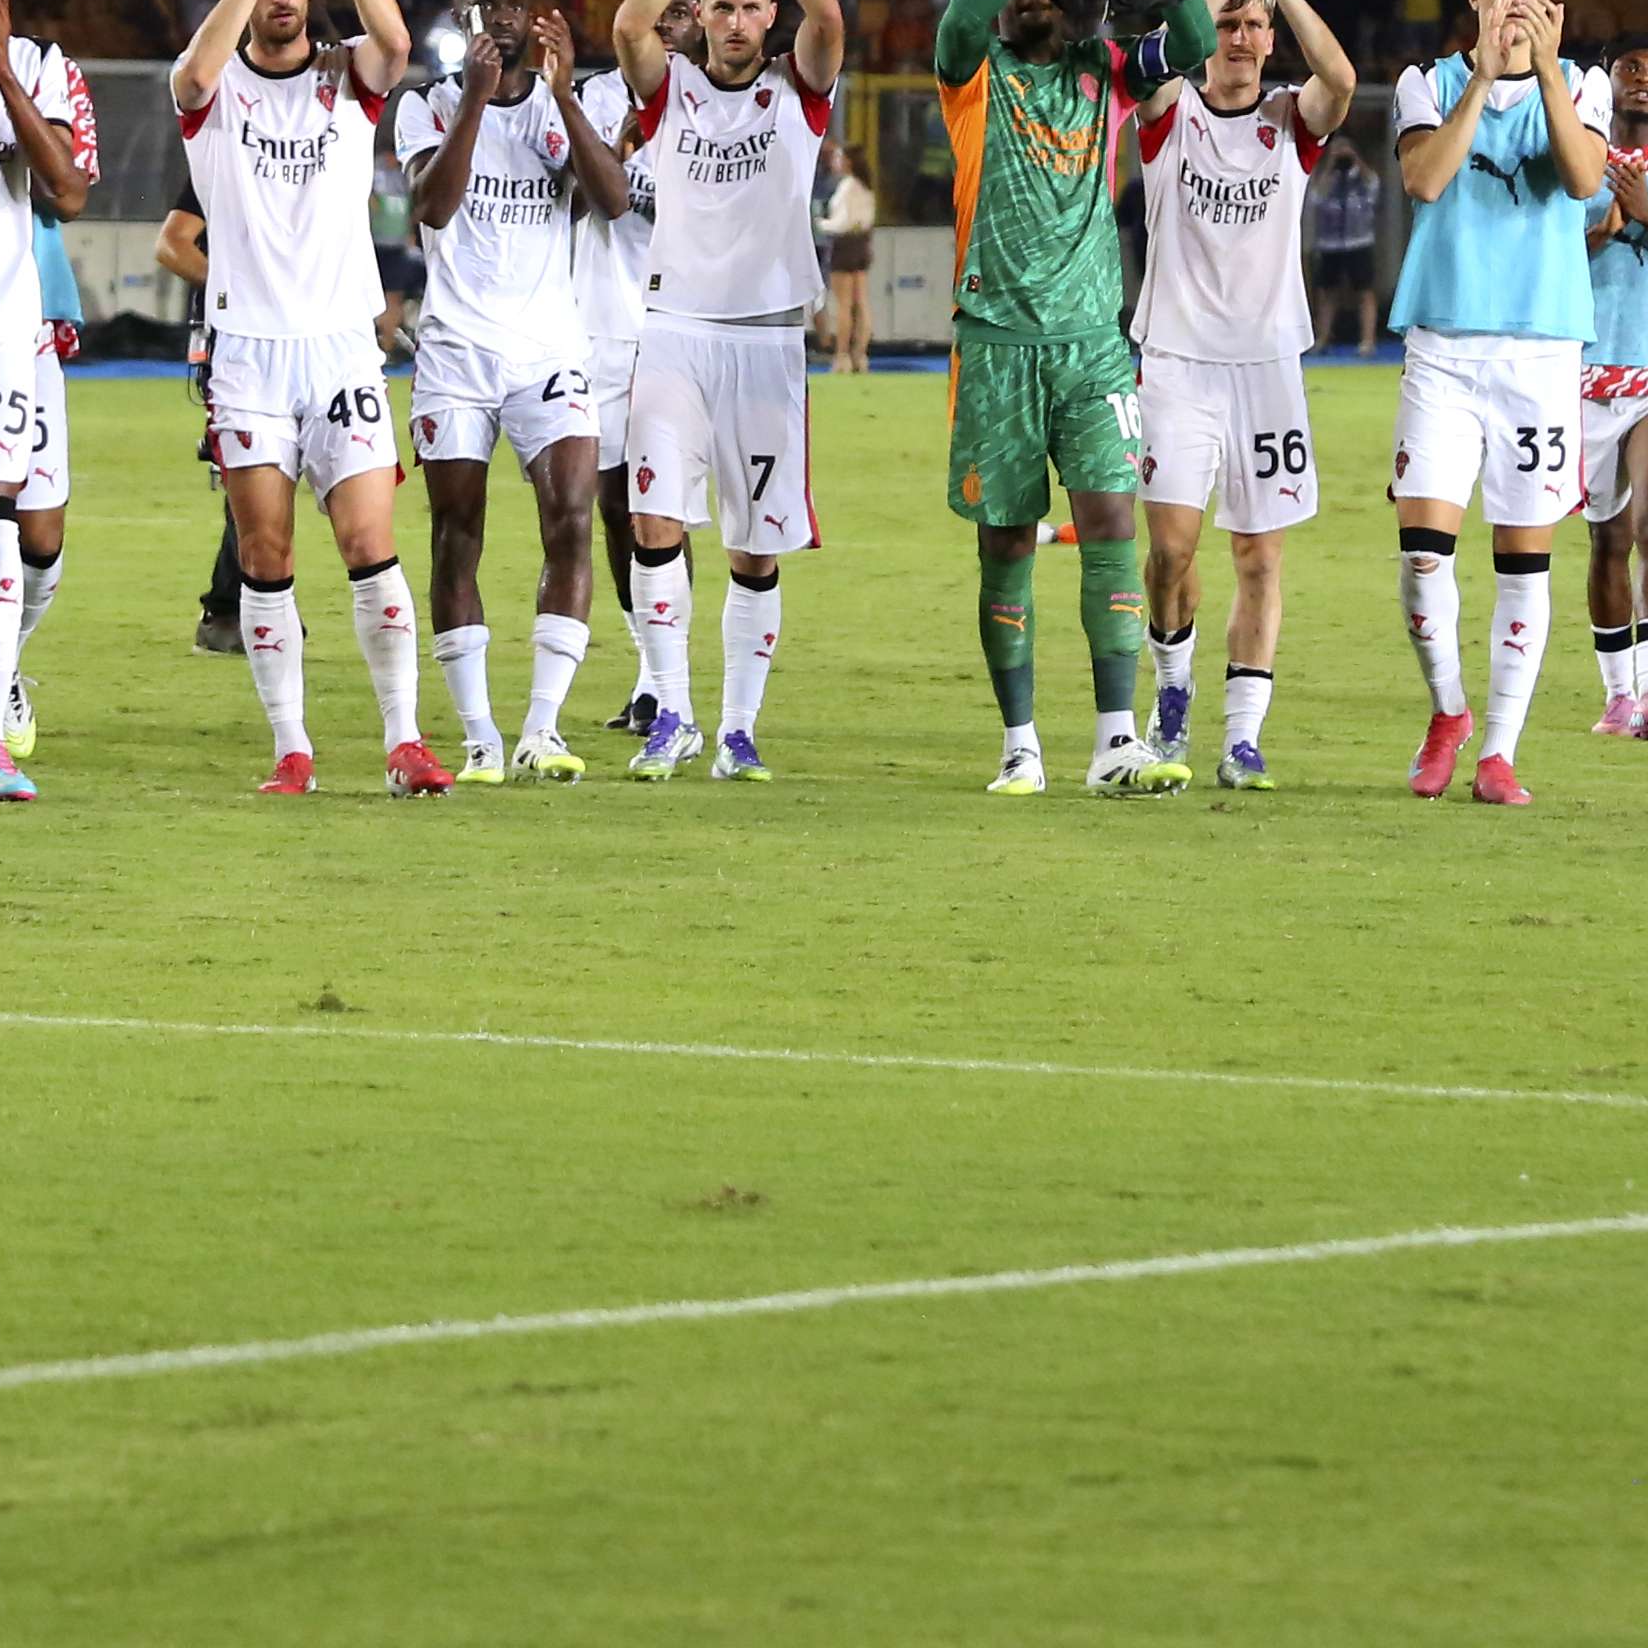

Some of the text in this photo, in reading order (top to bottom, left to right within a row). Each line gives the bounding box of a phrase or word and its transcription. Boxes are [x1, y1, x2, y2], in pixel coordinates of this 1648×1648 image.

[1180, 157, 1281, 201] Emirates
[470, 199, 553, 226] FLY BETTER
[1212, 200, 1268, 225] BETTER
[327, 386, 380, 428] 46
[1254, 429, 1307, 479] 56
[1516, 426, 1566, 472] 33
[751, 455, 776, 501] 7
